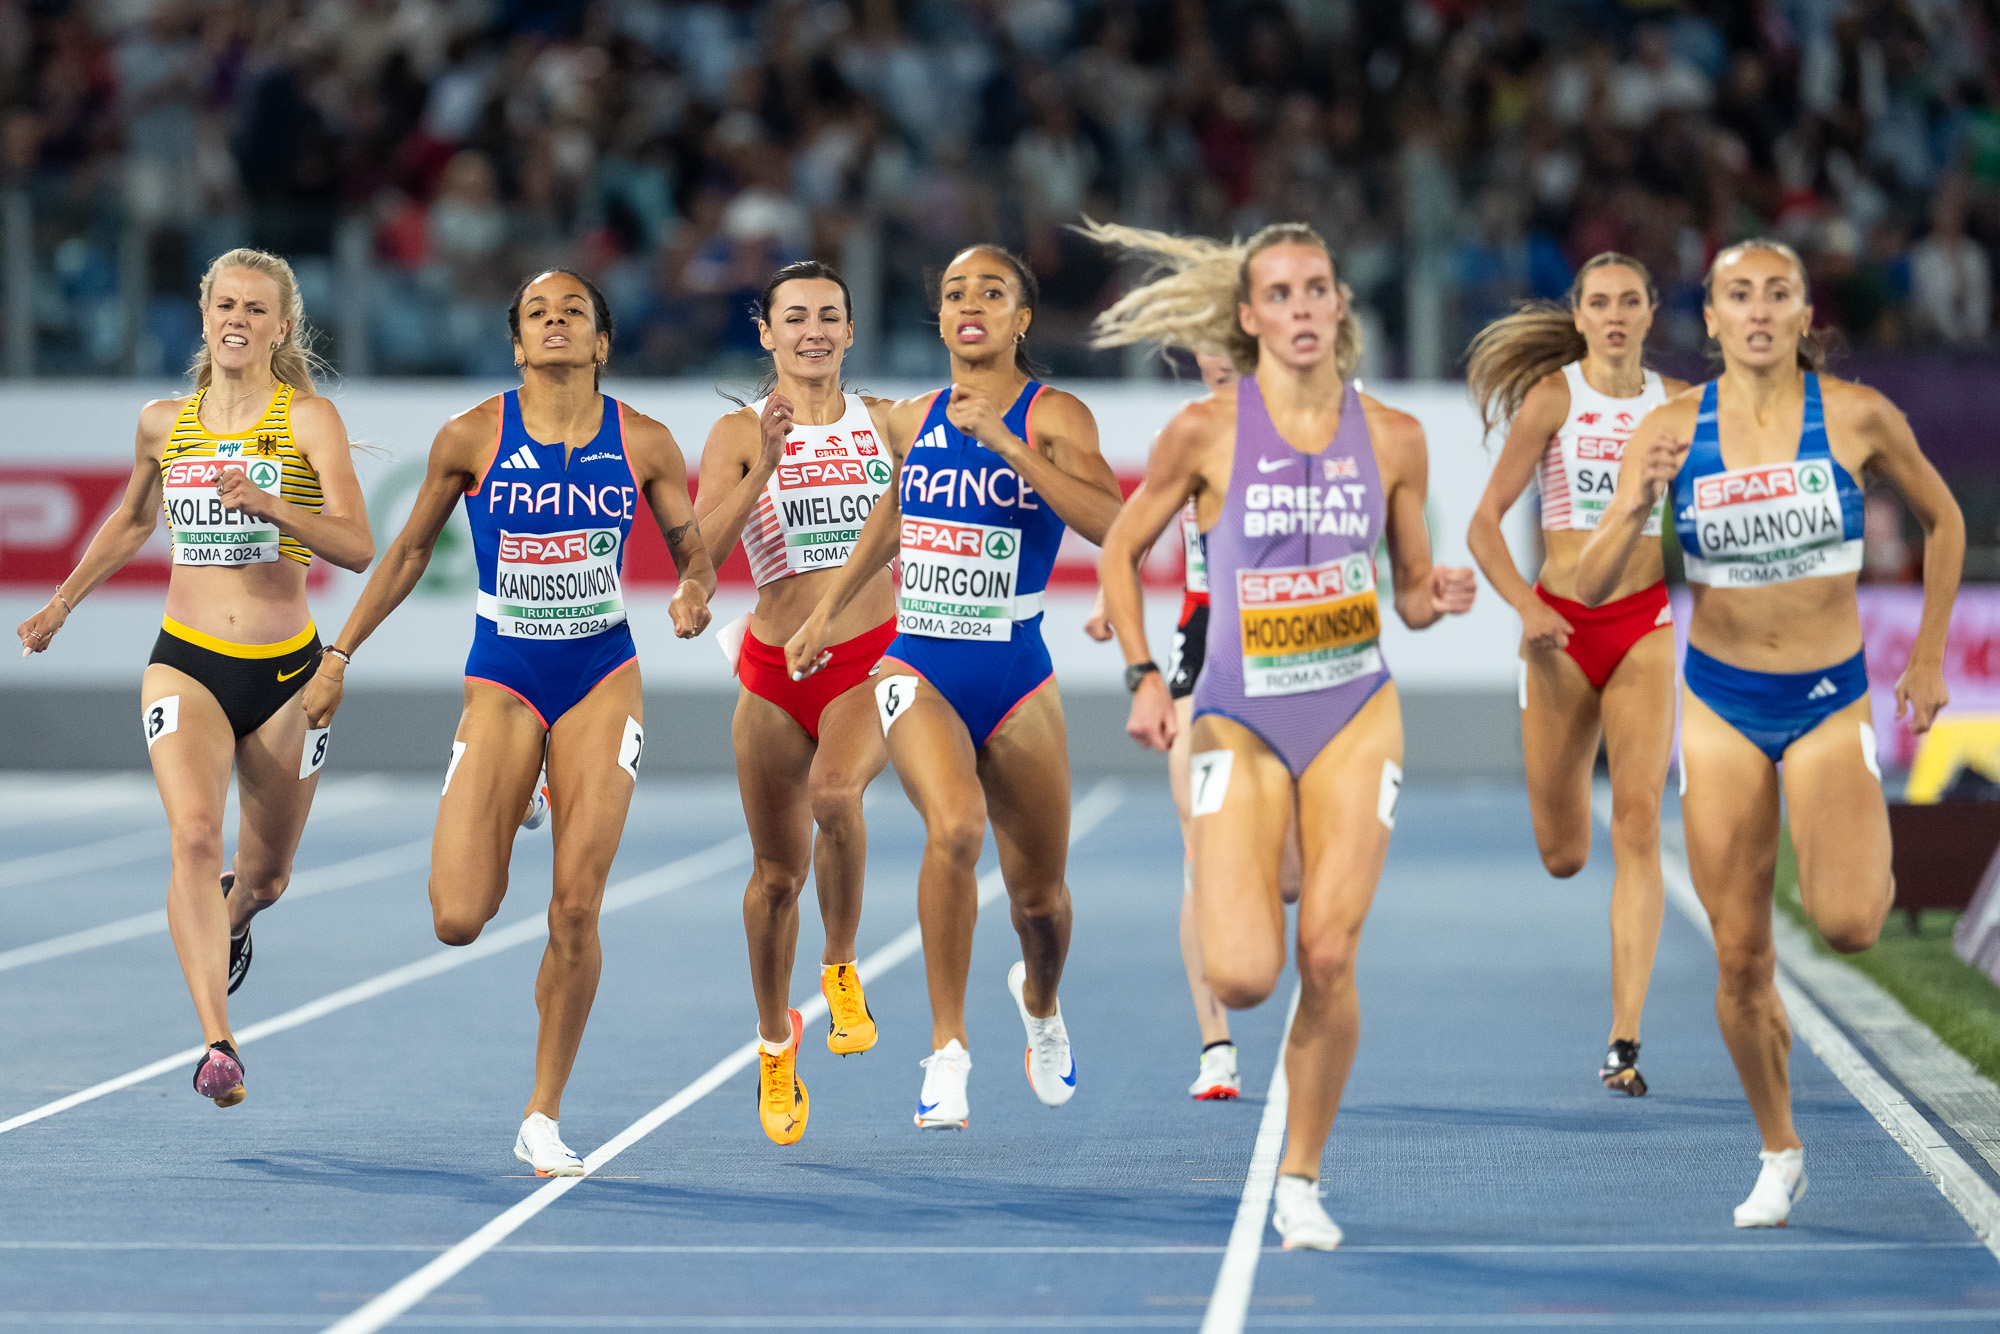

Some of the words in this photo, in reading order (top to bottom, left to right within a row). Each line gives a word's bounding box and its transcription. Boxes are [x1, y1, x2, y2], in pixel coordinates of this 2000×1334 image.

[817, 449, 846, 457] ORLEN
[780, 463, 864, 486] SPAR
[1701, 470, 1794, 507] SPAR
[489, 480, 634, 520] FRANCE
[782, 493, 882, 528] WIELGO
[1245, 483, 1366, 511] GREAT
[191, 533, 211, 543] RUN
[816, 532, 839, 543] RUN
[902, 522, 980, 554] SPAR
[1243, 510, 1370, 538] BRITAIN
[1703, 498, 1837, 551] GAJANOVÁ
[183, 548, 222, 561] ROMA
[224, 547, 262, 561] 2024
[501, 537, 586, 562] SPAR
[803, 546, 849, 563] ROMA
[1728, 565, 1782, 583] ROMA
[1786, 550, 1826, 577] 2024
[500, 564, 617, 601] KANDISSOUNON
[1242, 569, 1342, 602] SPAR
[527, 608, 554, 618] RUN
[910, 600, 937, 612] RUN
[514, 621, 565, 636] ROMA
[569, 618, 609, 635] 2024
[899, 615, 945, 633] ROMA
[950, 620, 992, 636] 2024
[1245, 601, 1376, 648] HODGKINSON
[886, 684, 900, 717] 6
[148, 706, 165, 739] 8
[311, 732, 329, 767] 8
